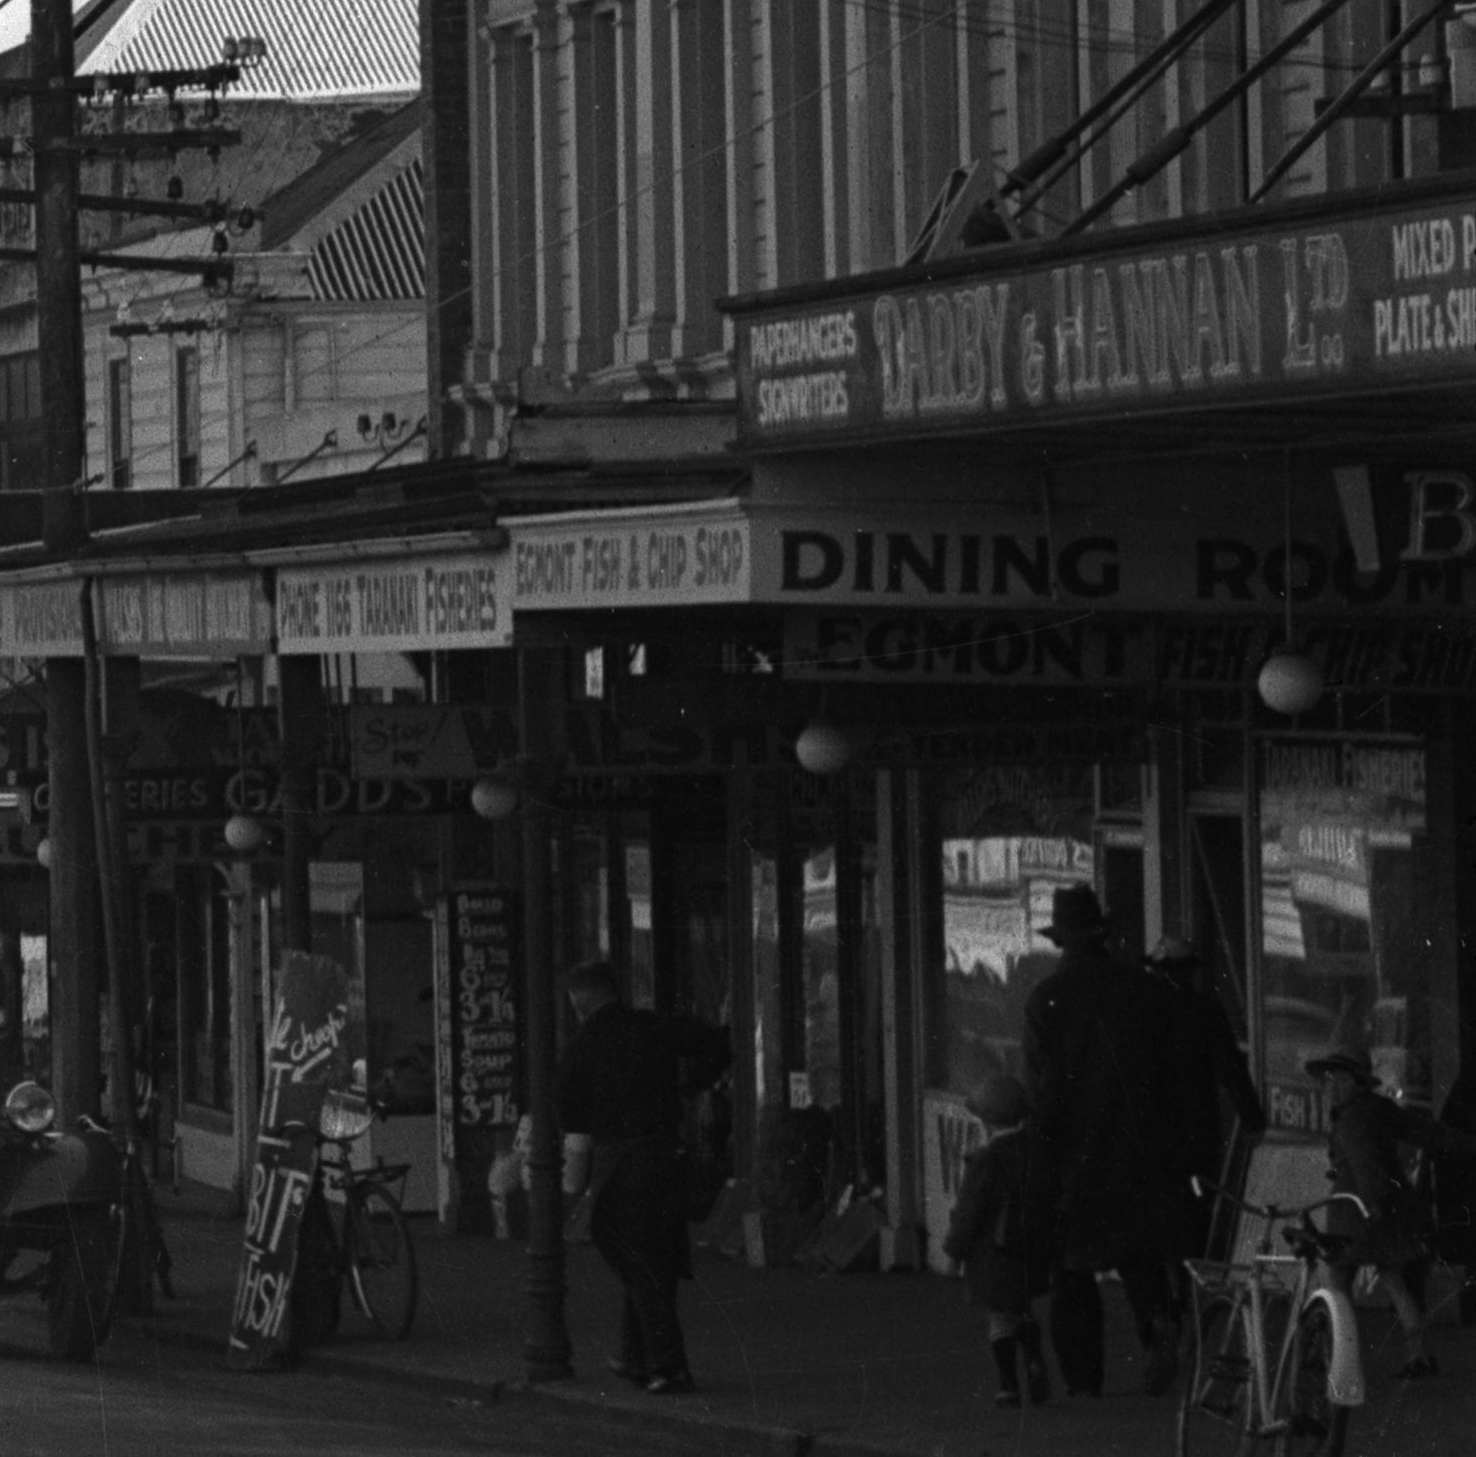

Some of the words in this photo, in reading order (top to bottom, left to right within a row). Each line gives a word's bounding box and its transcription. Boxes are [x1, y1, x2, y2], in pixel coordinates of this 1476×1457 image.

[872, 293, 1010, 413] DARBY
[1051, 243, 1263, 394] HANNAN
[1391, 218, 1455, 281] MIXED
[1373, 294, 1432, 356] PLATE
[583, 535, 622, 592] FISH
[647, 529, 689, 588] CHIP
[694, 526, 744, 586] SHOP
[781, 528, 1122, 601] DINING
[280, 579, 321, 637] PHONE
[424, 567, 497, 633] FISHERIES
